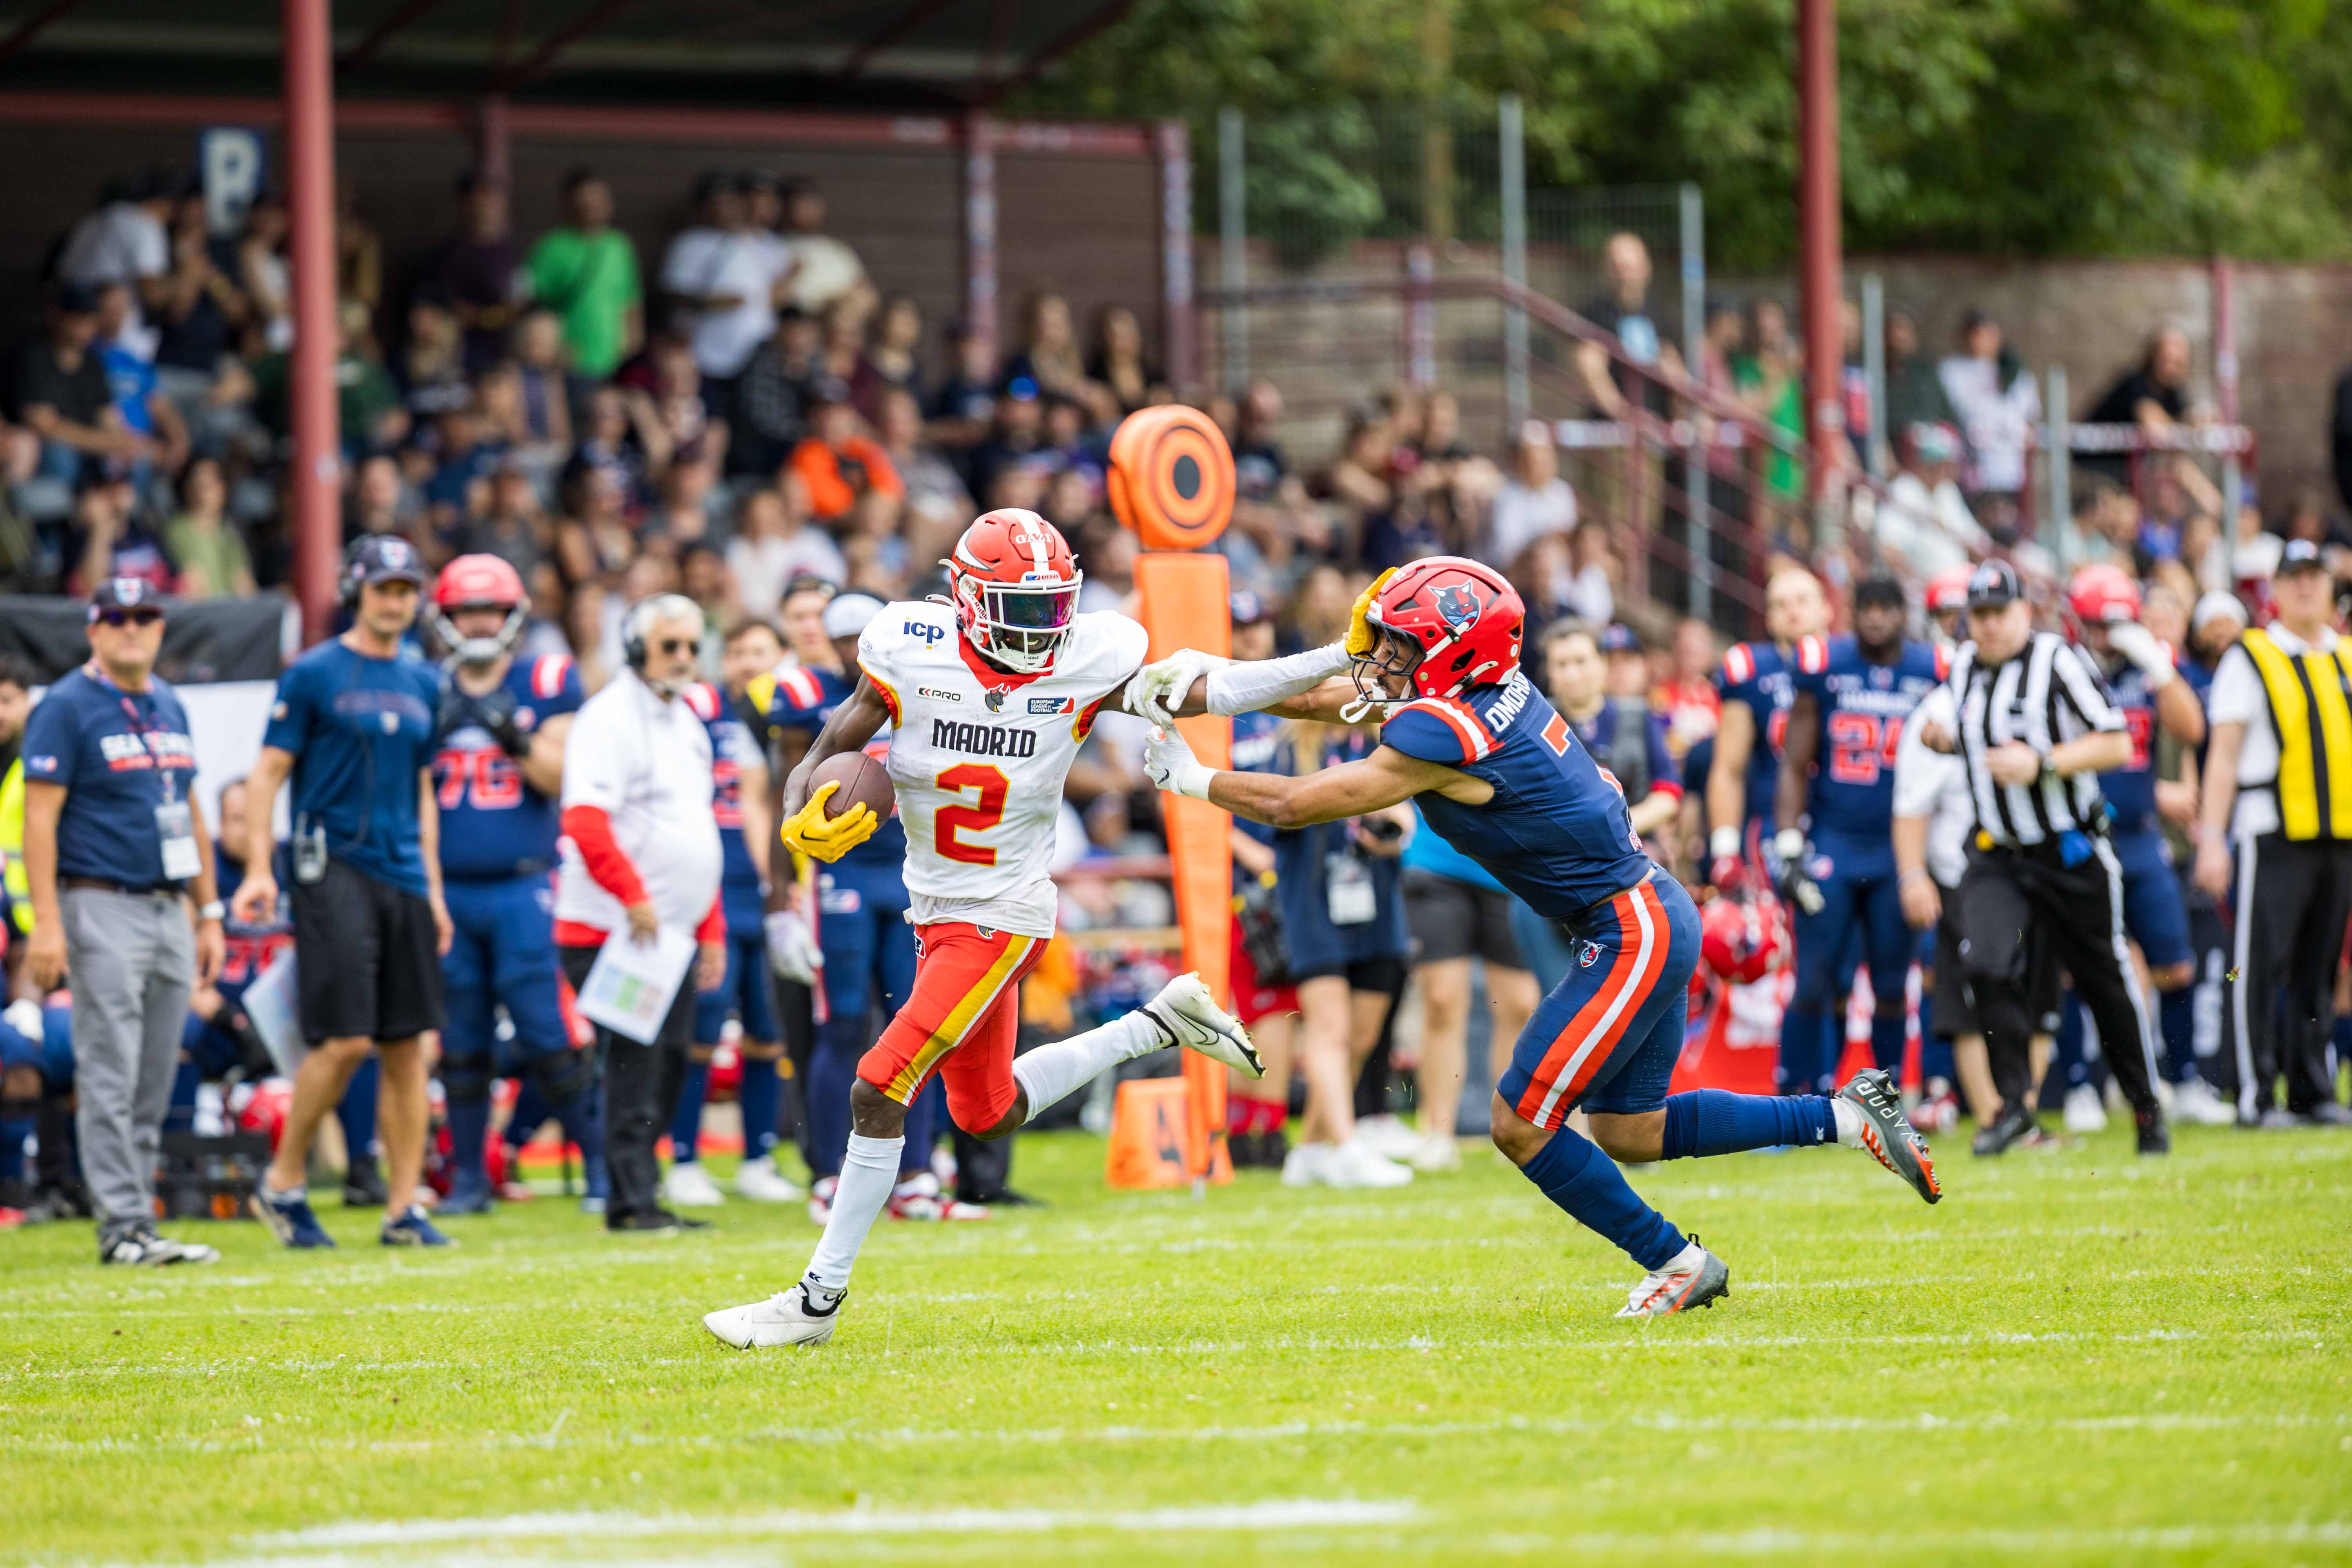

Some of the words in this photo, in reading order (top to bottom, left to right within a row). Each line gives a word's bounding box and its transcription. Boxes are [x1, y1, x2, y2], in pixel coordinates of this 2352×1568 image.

[904, 617, 945, 649] icp
[932, 718, 1036, 758] MADRID
[934, 762, 1011, 867] 2
